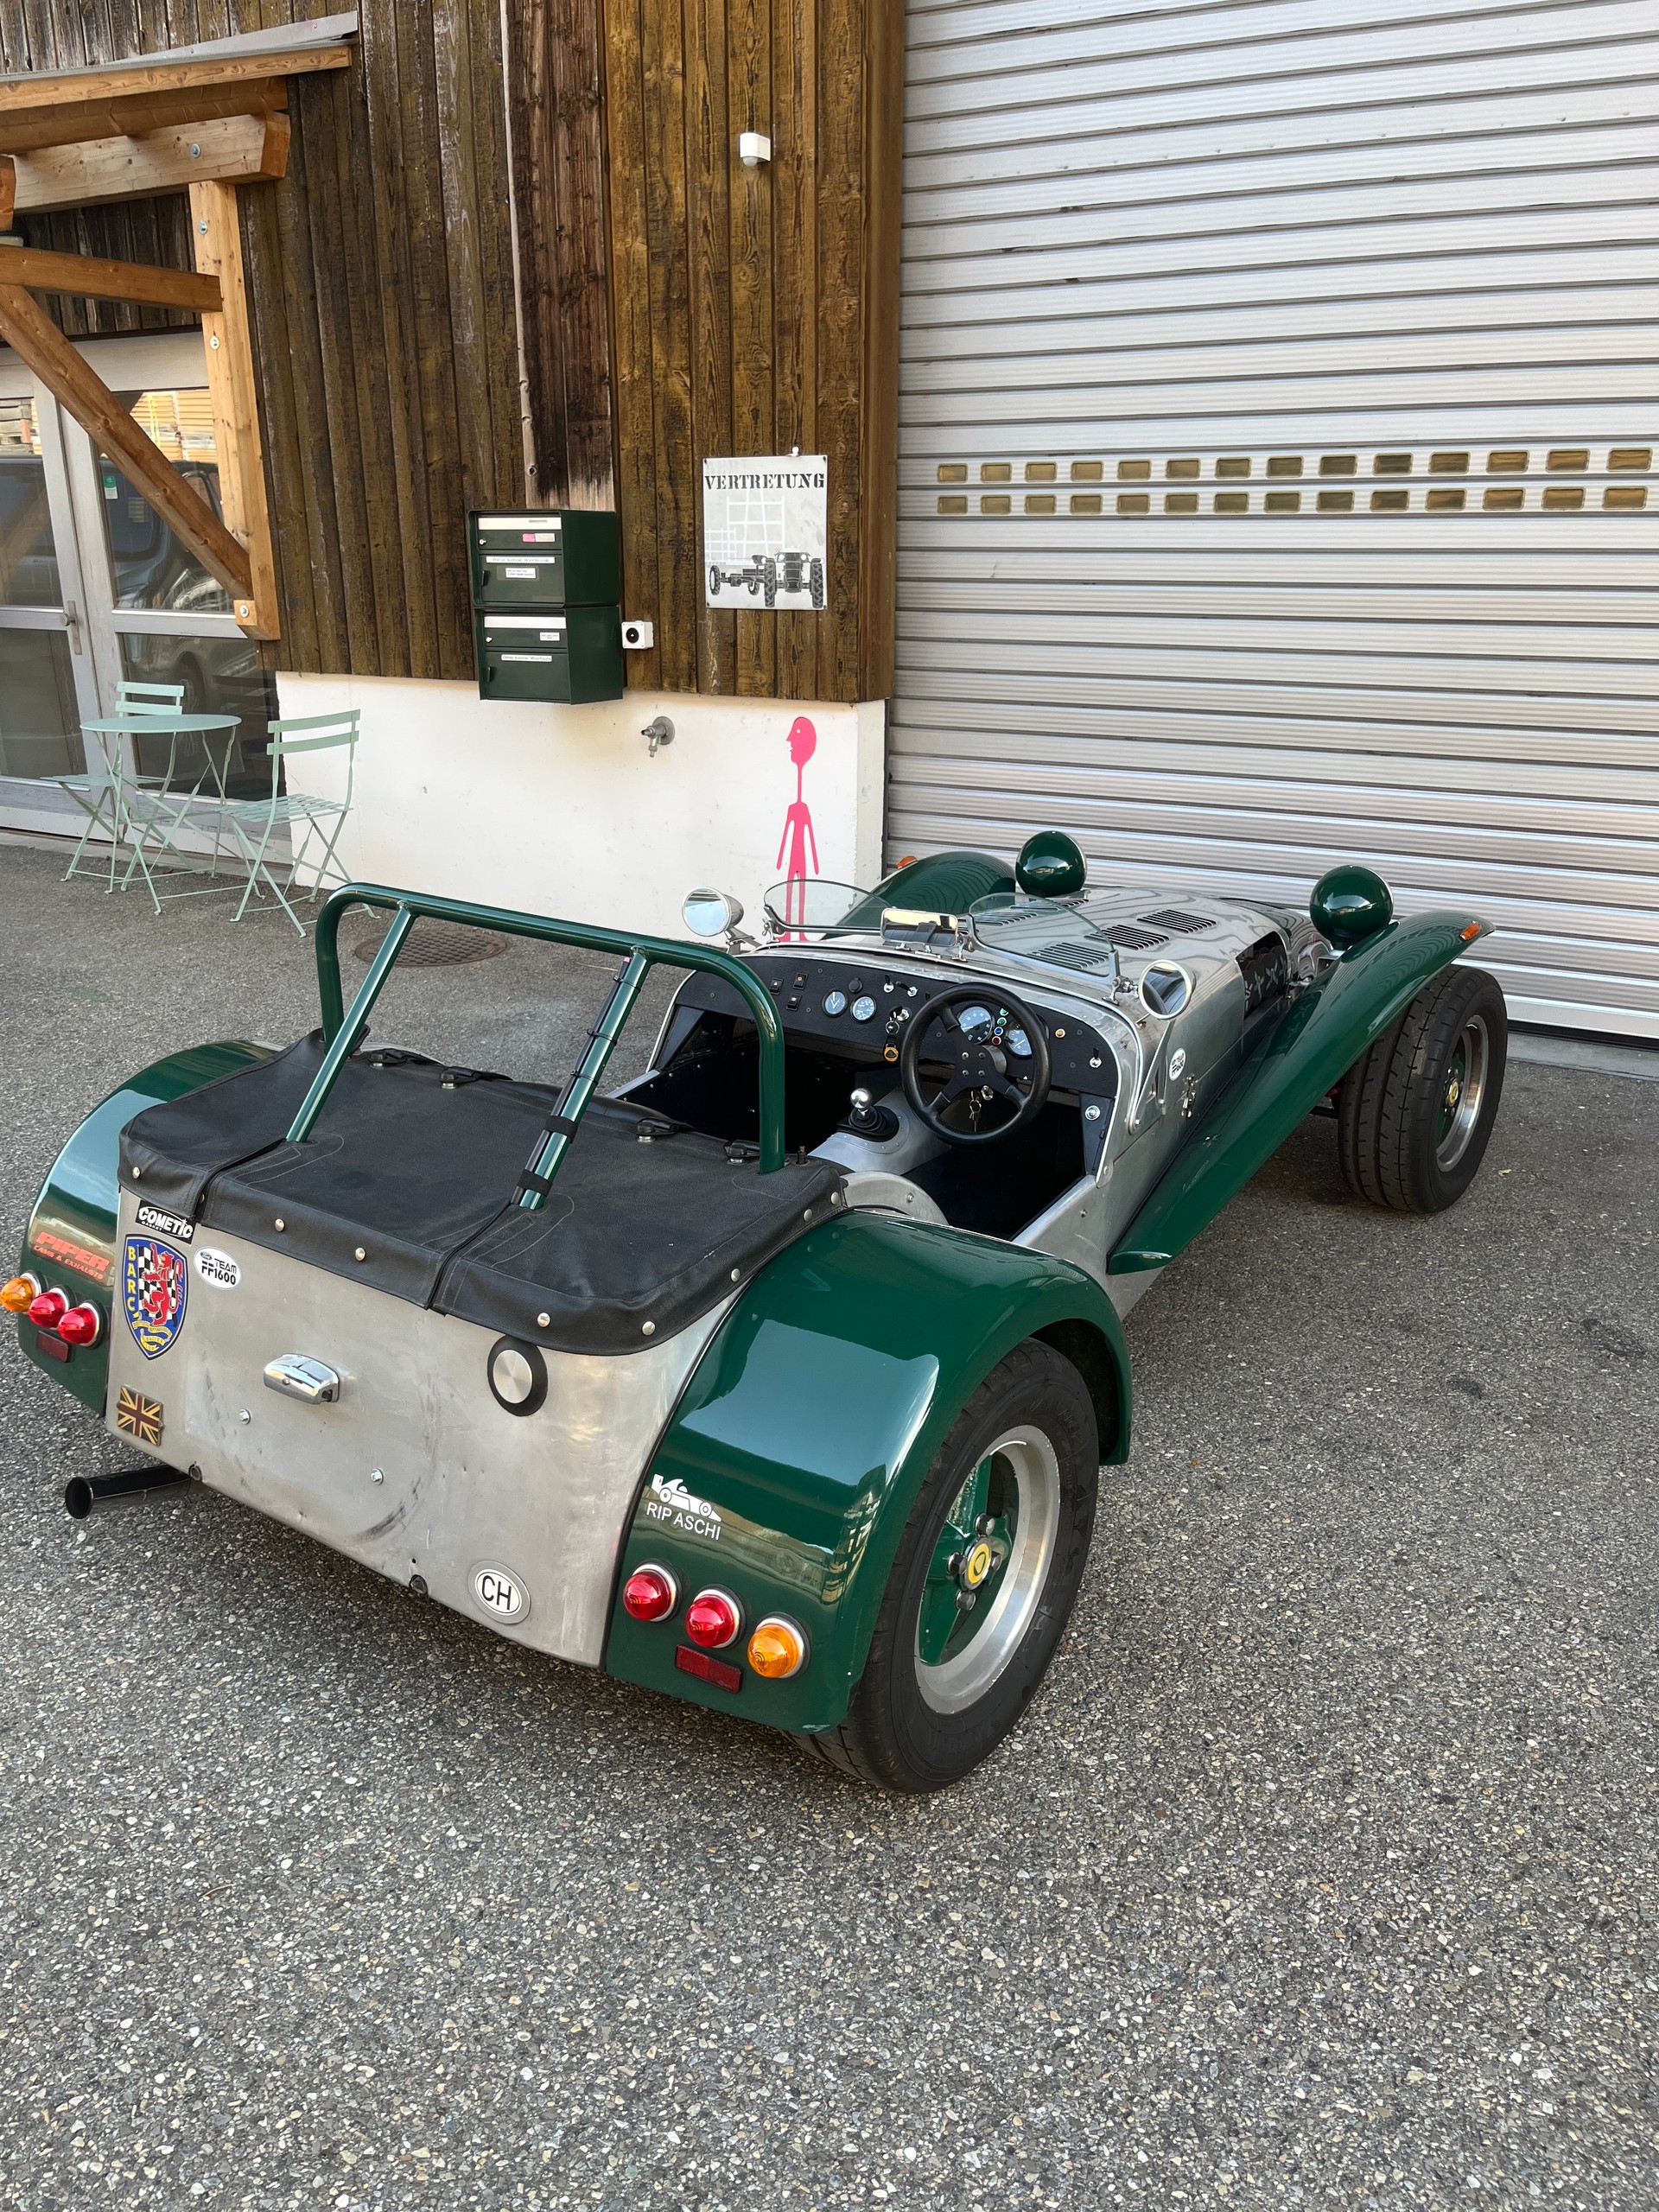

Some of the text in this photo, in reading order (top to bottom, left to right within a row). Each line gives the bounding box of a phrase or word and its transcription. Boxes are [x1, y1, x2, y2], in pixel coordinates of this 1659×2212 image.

[704, 473, 824, 490] VERTRETUNG
[138, 1206, 194, 1239] COMETIC
[34, 1245, 55, 1258] CAMS
[64, 1258, 104, 1280] EXHAUSTS
[35, 1231, 110, 1272] PIPER
[213, 1257, 238, 1274] TEAM
[127, 1245, 137, 1312] BARC
[201, 1260, 237, 1286] FF1600
[646, 1501, 721, 1541] RIP ASCHI
[481, 1574, 512, 1611] CH
